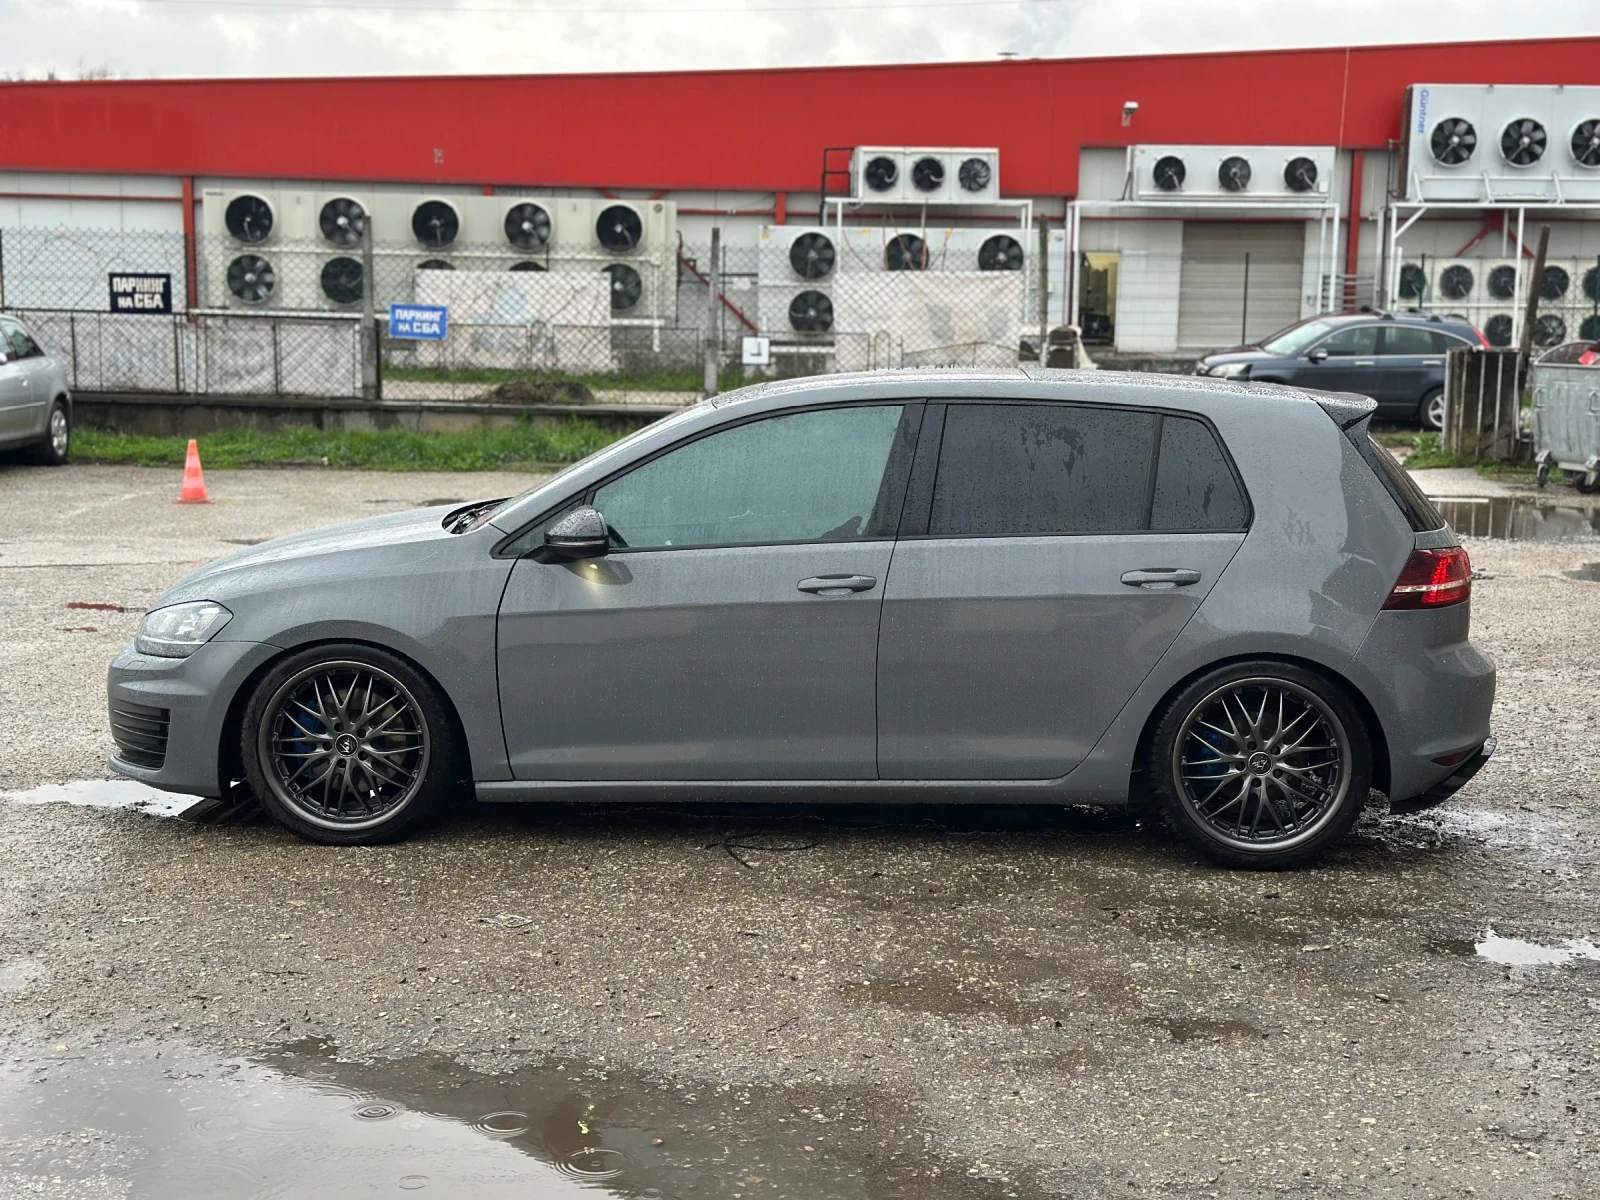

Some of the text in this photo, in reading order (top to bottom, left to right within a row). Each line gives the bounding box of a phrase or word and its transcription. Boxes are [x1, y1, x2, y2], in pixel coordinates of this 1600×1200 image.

[113, 277, 167, 293] ПАРКИНГ
[134, 293, 164, 309] СБА
[395, 309, 443, 322] ПАРКИНГ
[413, 321, 441, 334] СБА
